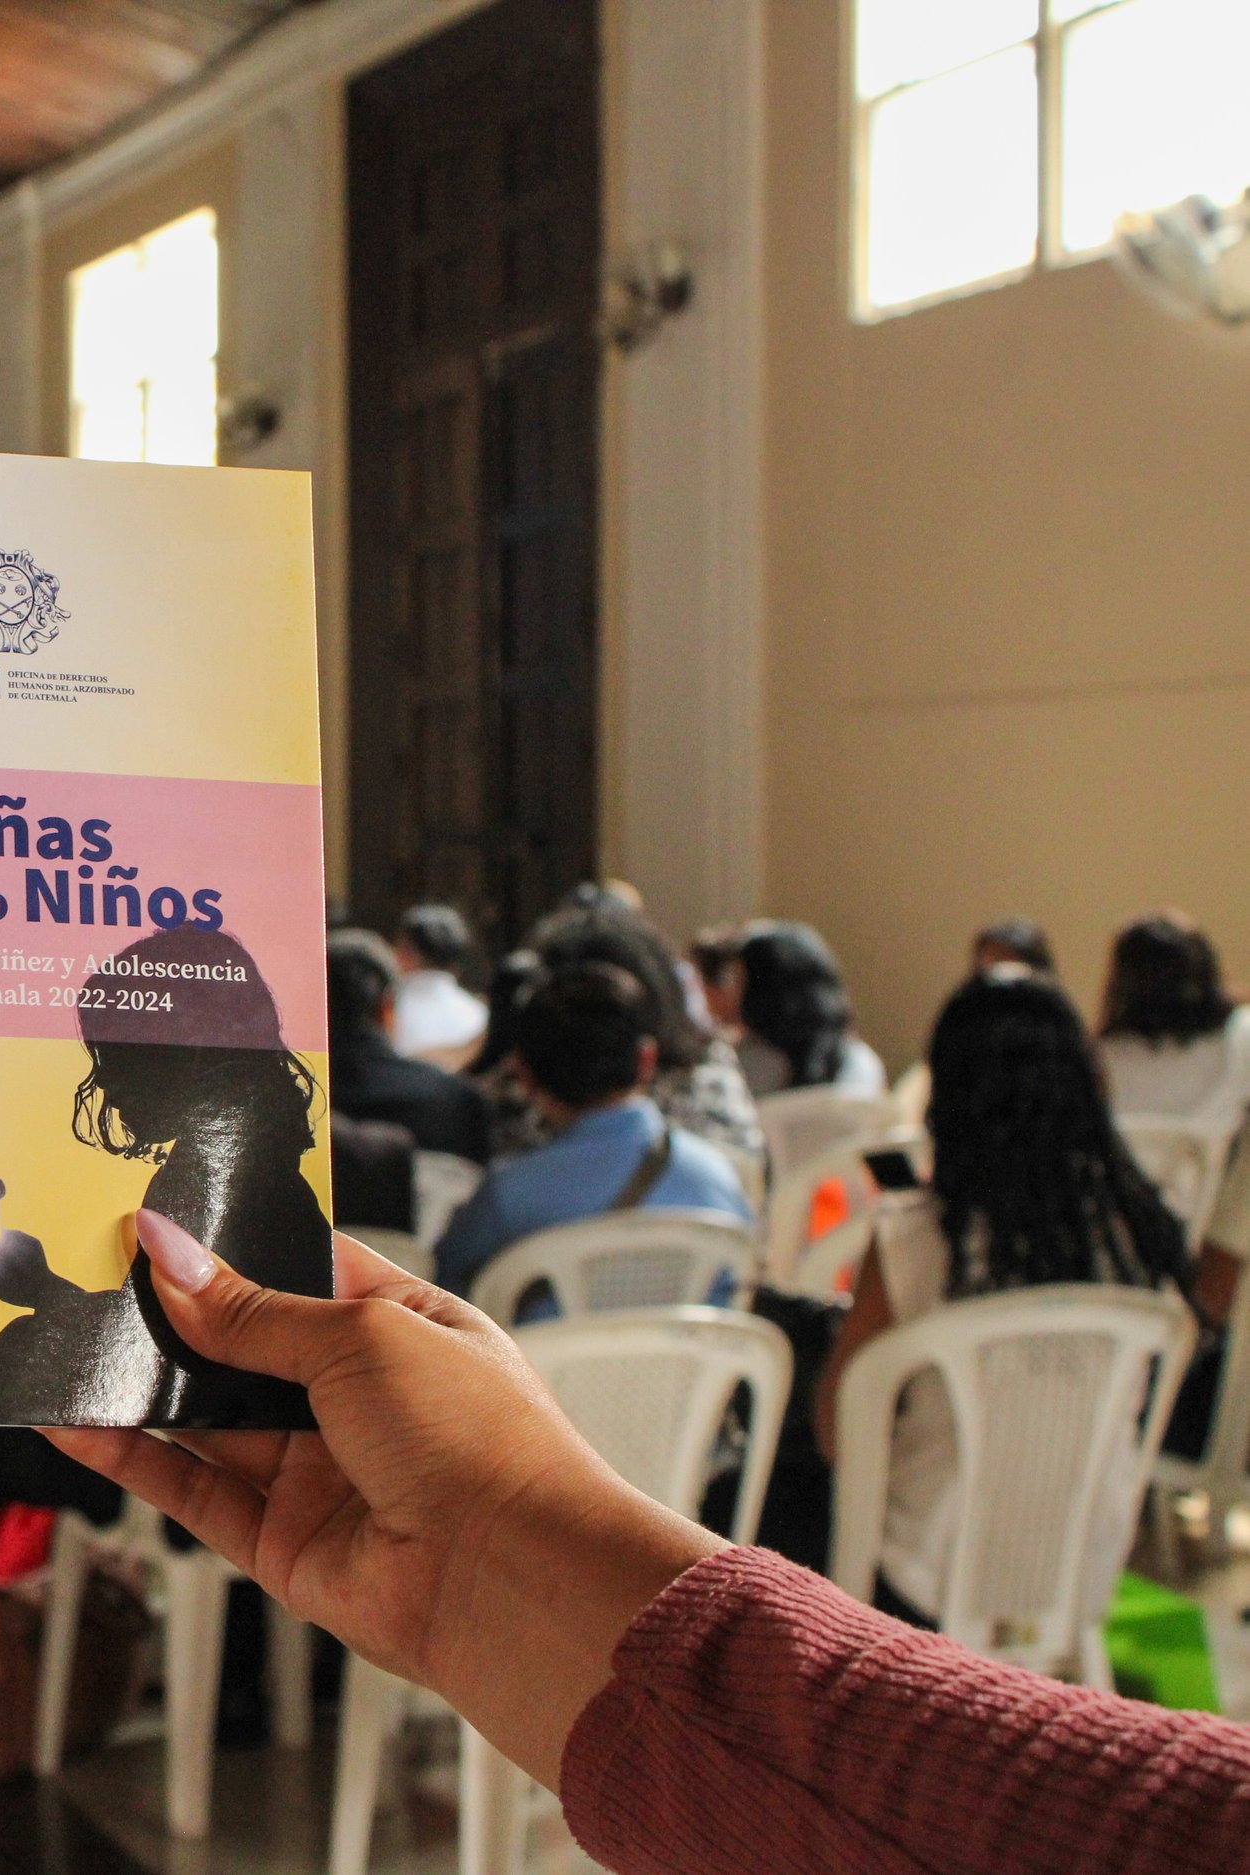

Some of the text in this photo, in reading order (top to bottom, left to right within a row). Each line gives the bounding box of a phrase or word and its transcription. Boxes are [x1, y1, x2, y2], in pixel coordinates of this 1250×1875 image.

[7, 670, 108, 683] OFICINA DE DERECHOS
[8, 681, 135, 696] HUMANOS DEL ARZOBISPADO
[8, 693, 78, 703] DE GUATEMALA
[25, 864, 224, 933] Niños
[60, 958, 75, 979] y
[83, 952, 248, 983] Adolescencia
[48, 986, 174, 1014] 2022-2024
